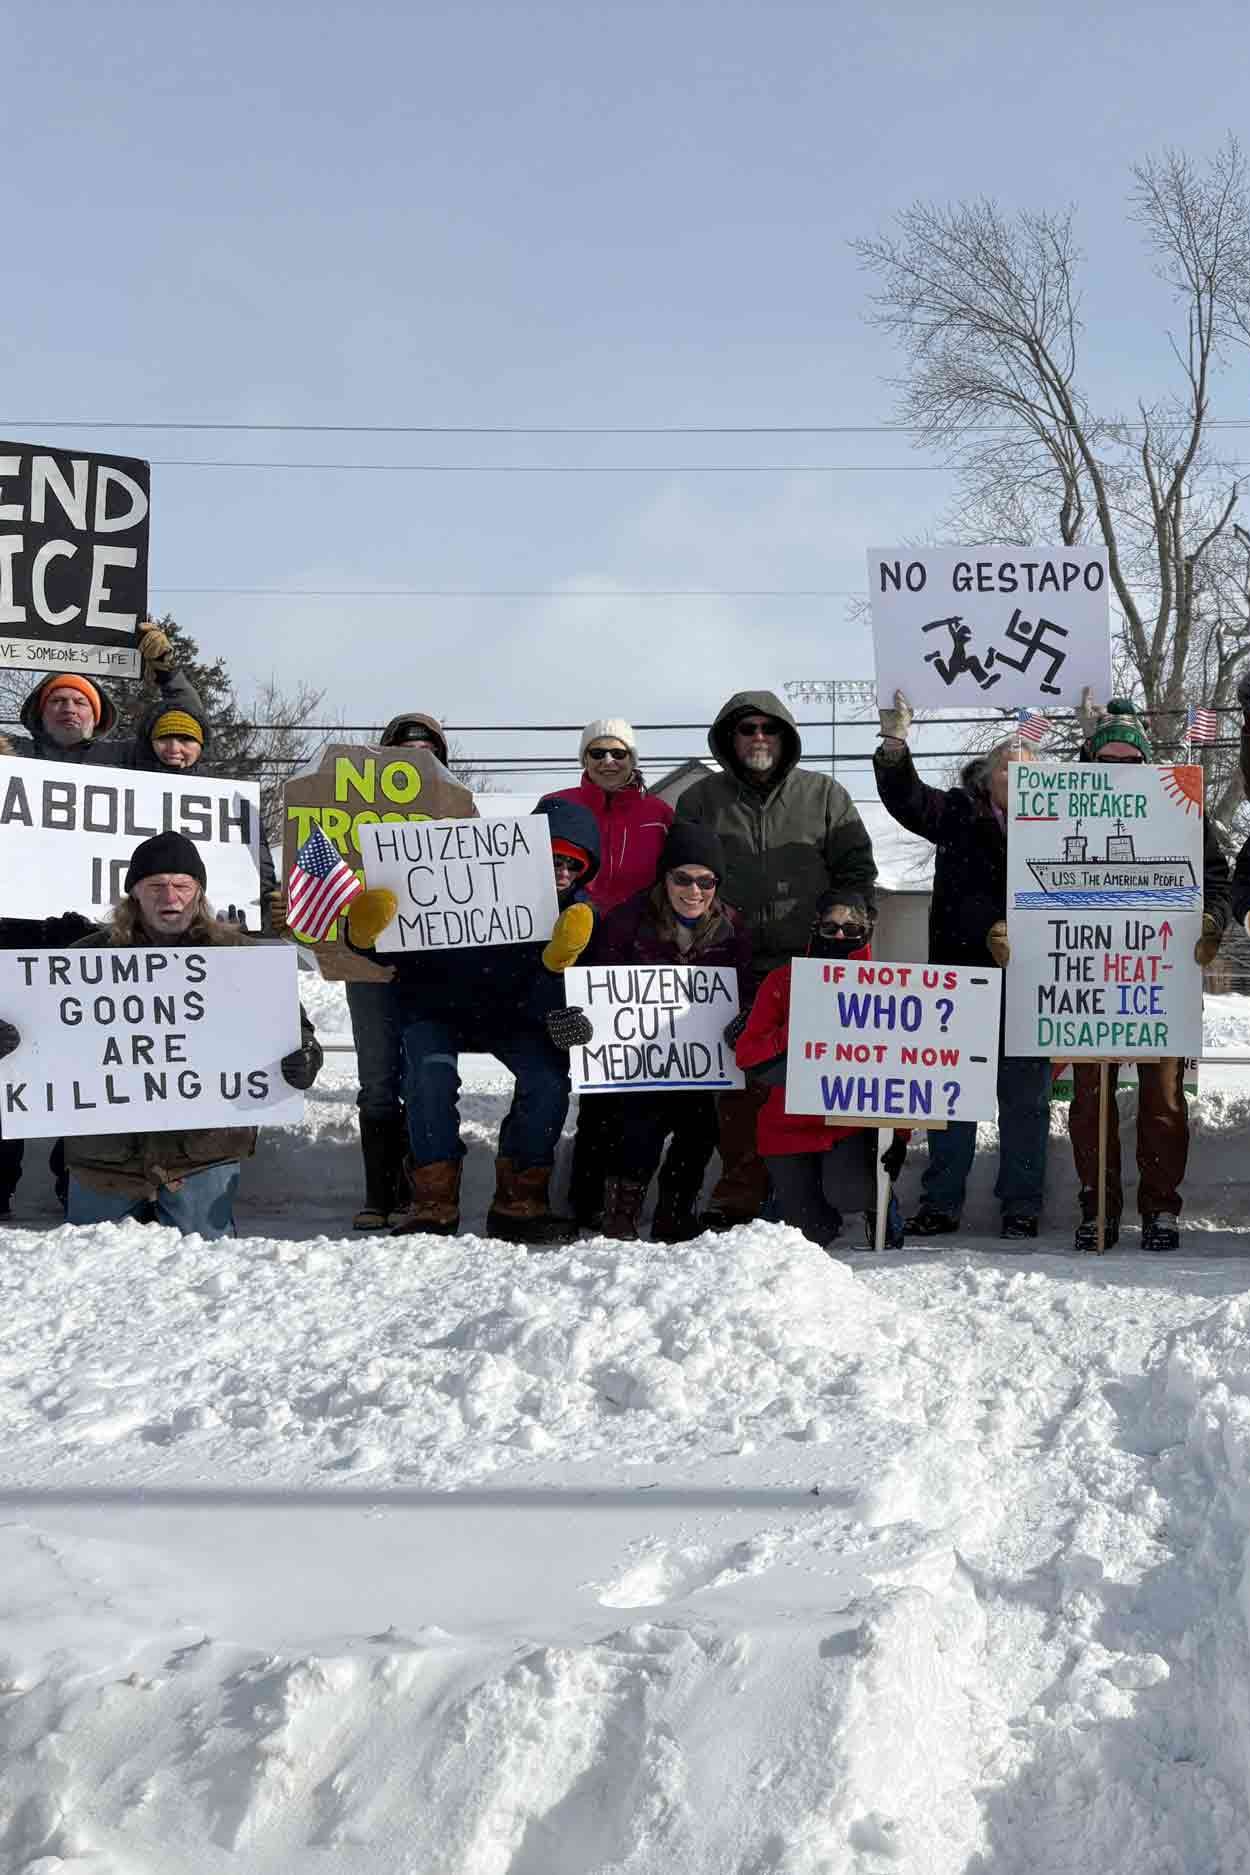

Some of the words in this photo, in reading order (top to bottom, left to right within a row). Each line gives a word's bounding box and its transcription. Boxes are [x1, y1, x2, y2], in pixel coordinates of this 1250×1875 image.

[0, 456, 148, 532] END
[0, 534, 138, 634] ICE
[880, 561, 927, 593] NO
[952, 561, 1104, 593] GESTAPO
[27, 645, 89, 663] SOMEONE'S
[335, 757, 422, 804] NO
[1016, 766, 1113, 791] POWERFUL
[0, 776, 250, 844] ABOLISH
[1016, 791, 1058, 818] ICE
[1068, 792, 1147, 818] BREAKER
[375, 821, 530, 863] HUIZENGA
[407, 862, 506, 907] CUT
[1052, 871, 1076, 887] USS
[1082, 871, 1100, 886] THE
[1103, 873, 1149, 887] AMERICAN
[1154, 873, 1185, 887] PEOPLE
[398, 905, 533, 947] MEDICAID
[1048, 920, 1112, 950] TURN
[1125, 920, 1156, 951] UP
[17, 953, 208, 986] TRUMP'S
[823, 965, 845, 984] IF
[858, 966, 912, 987] NOT
[923, 971, 958, 990] US
[1048, 952, 1096, 983] THE
[586, 967, 733, 1005] HUIZENGA
[1038, 985, 1105, 1015] MAKE
[60, 991, 205, 1026] GOONS
[613, 1006, 683, 1041] CUT
[1038, 1017, 1168, 1048] DISAPPEAR
[102, 1034, 187, 1066] ARE
[581, 1041, 726, 1082] MEDICAID!
[804, 1041, 827, 1060] IF
[835, 1043, 888, 1064] NOT
[901, 1047, 960, 1067] NOW
[6, 1071, 201, 1113] KILLNG
[220, 1071, 269, 1100] US
